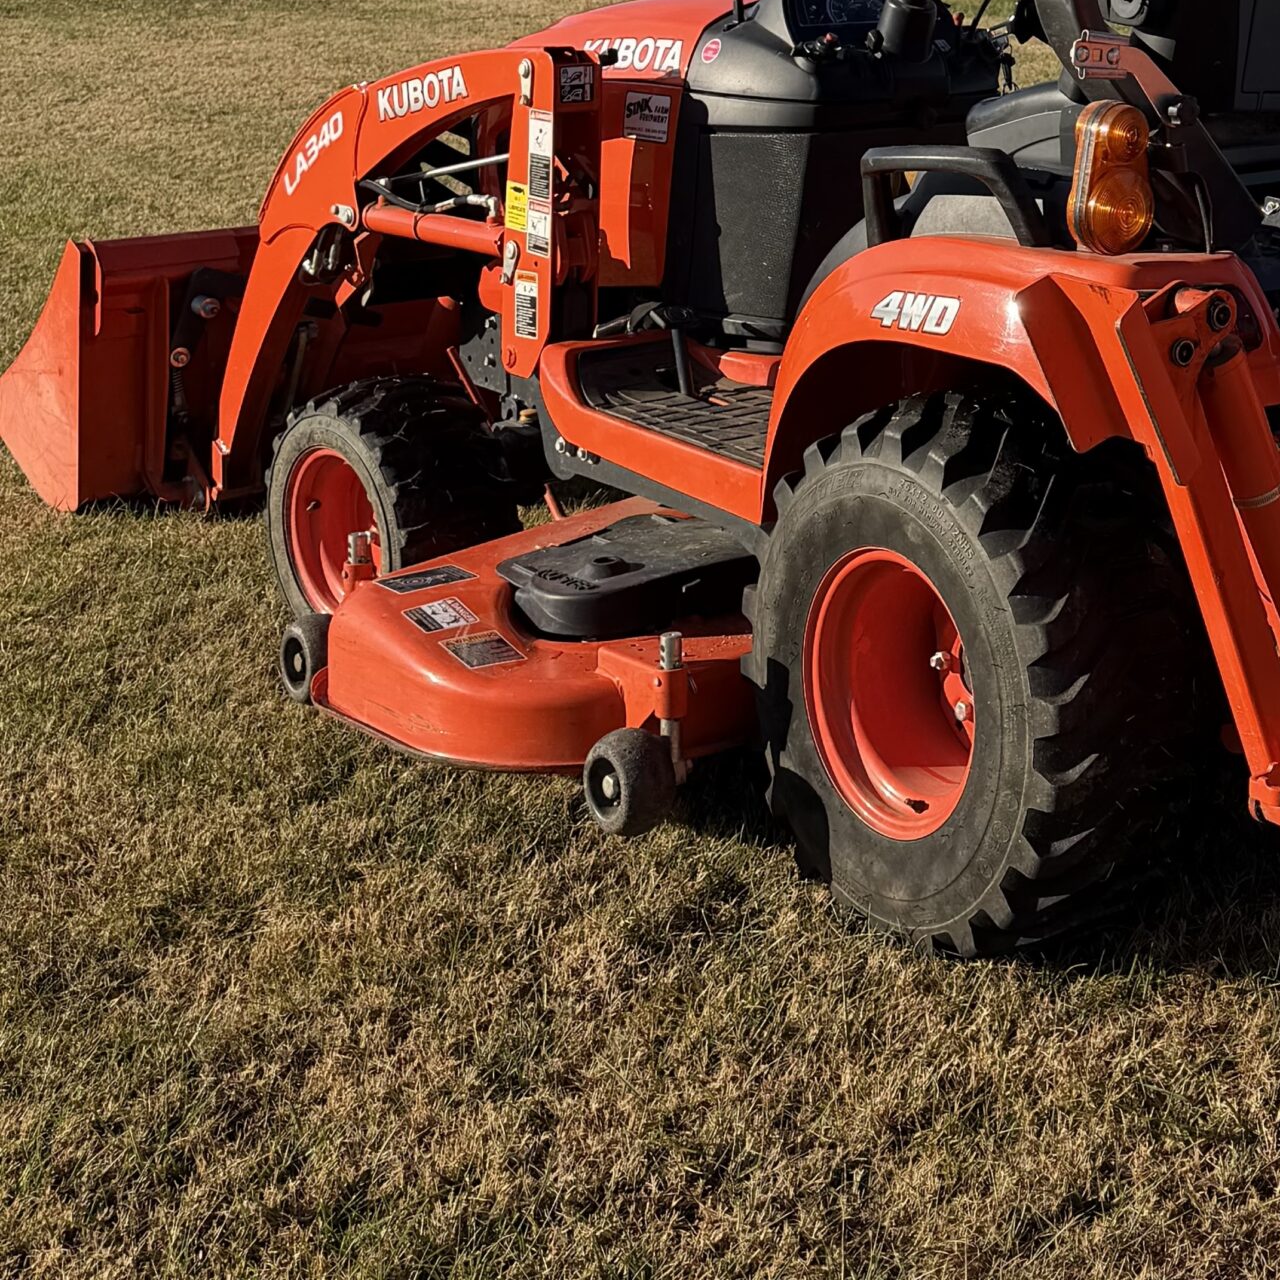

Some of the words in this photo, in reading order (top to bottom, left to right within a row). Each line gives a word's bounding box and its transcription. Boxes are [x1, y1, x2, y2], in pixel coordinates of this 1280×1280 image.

[377, 64, 468, 122] KUBOTA
[626, 96, 652, 118] SINK
[284, 111, 344, 196] LA340
[870, 289, 961, 336] 4WD
